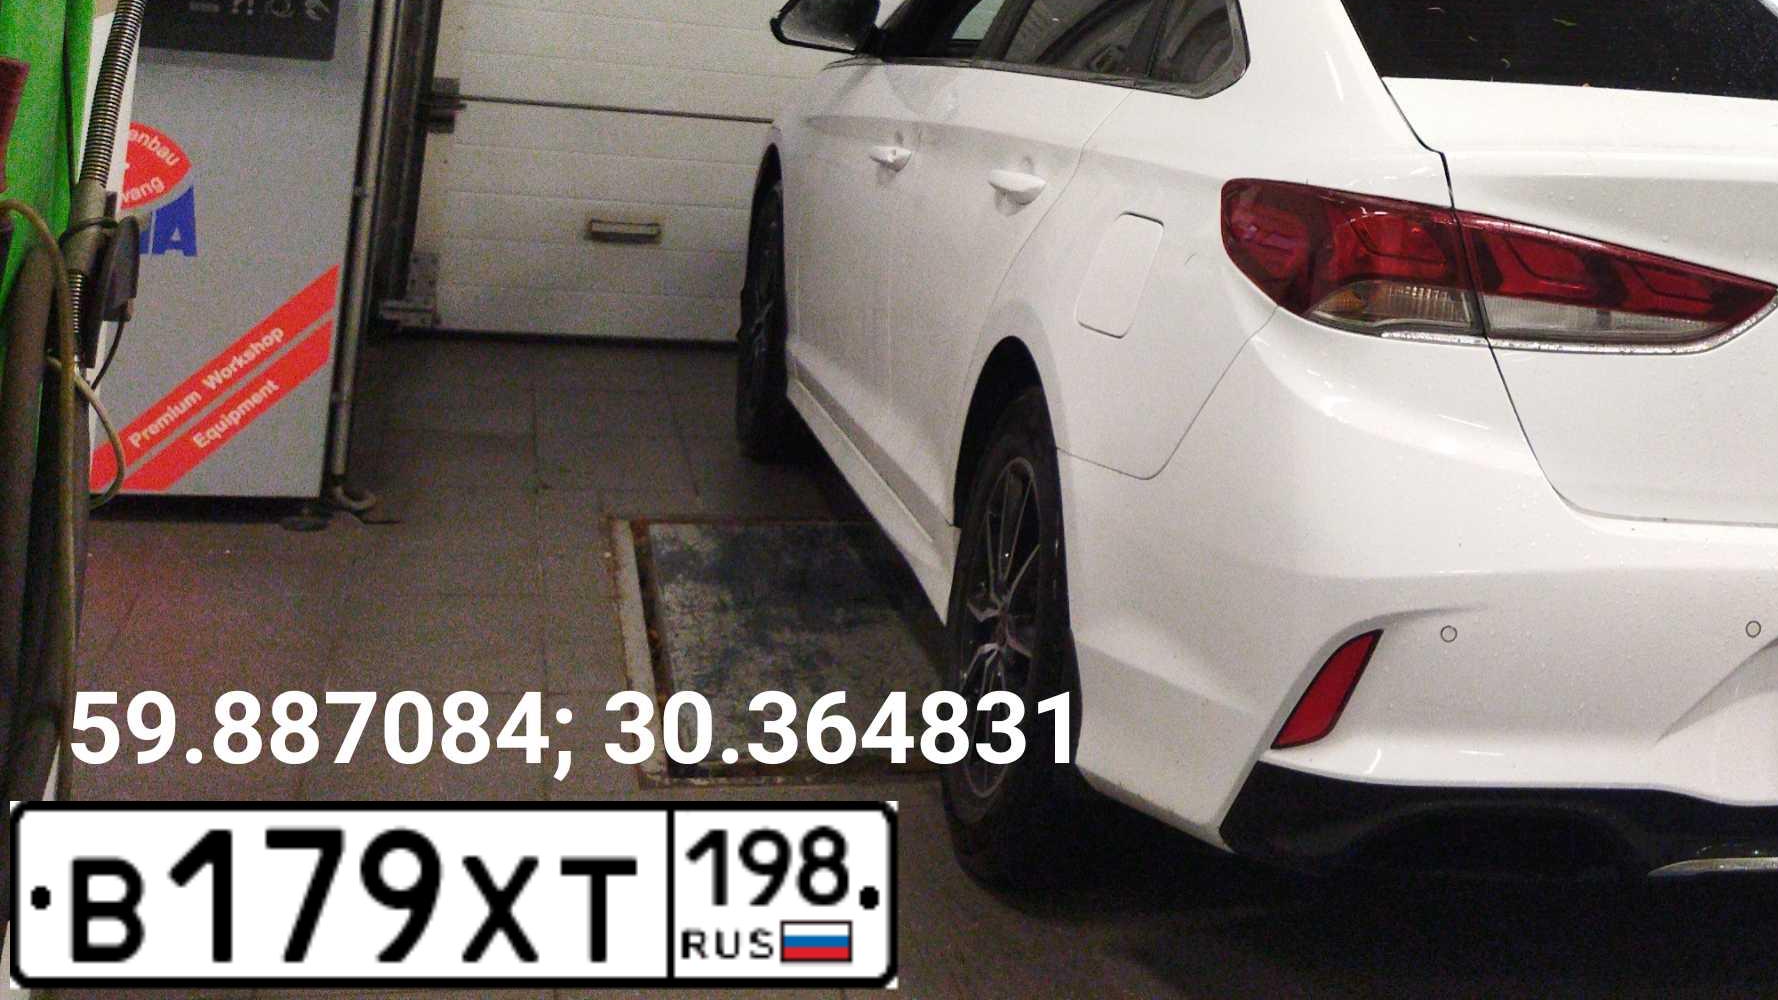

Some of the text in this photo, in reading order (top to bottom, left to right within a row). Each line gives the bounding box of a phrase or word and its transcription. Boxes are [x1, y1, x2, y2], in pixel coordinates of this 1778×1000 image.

[128, 327, 285, 449] Premium Workshop
[192, 379, 281, 449] Equipment
